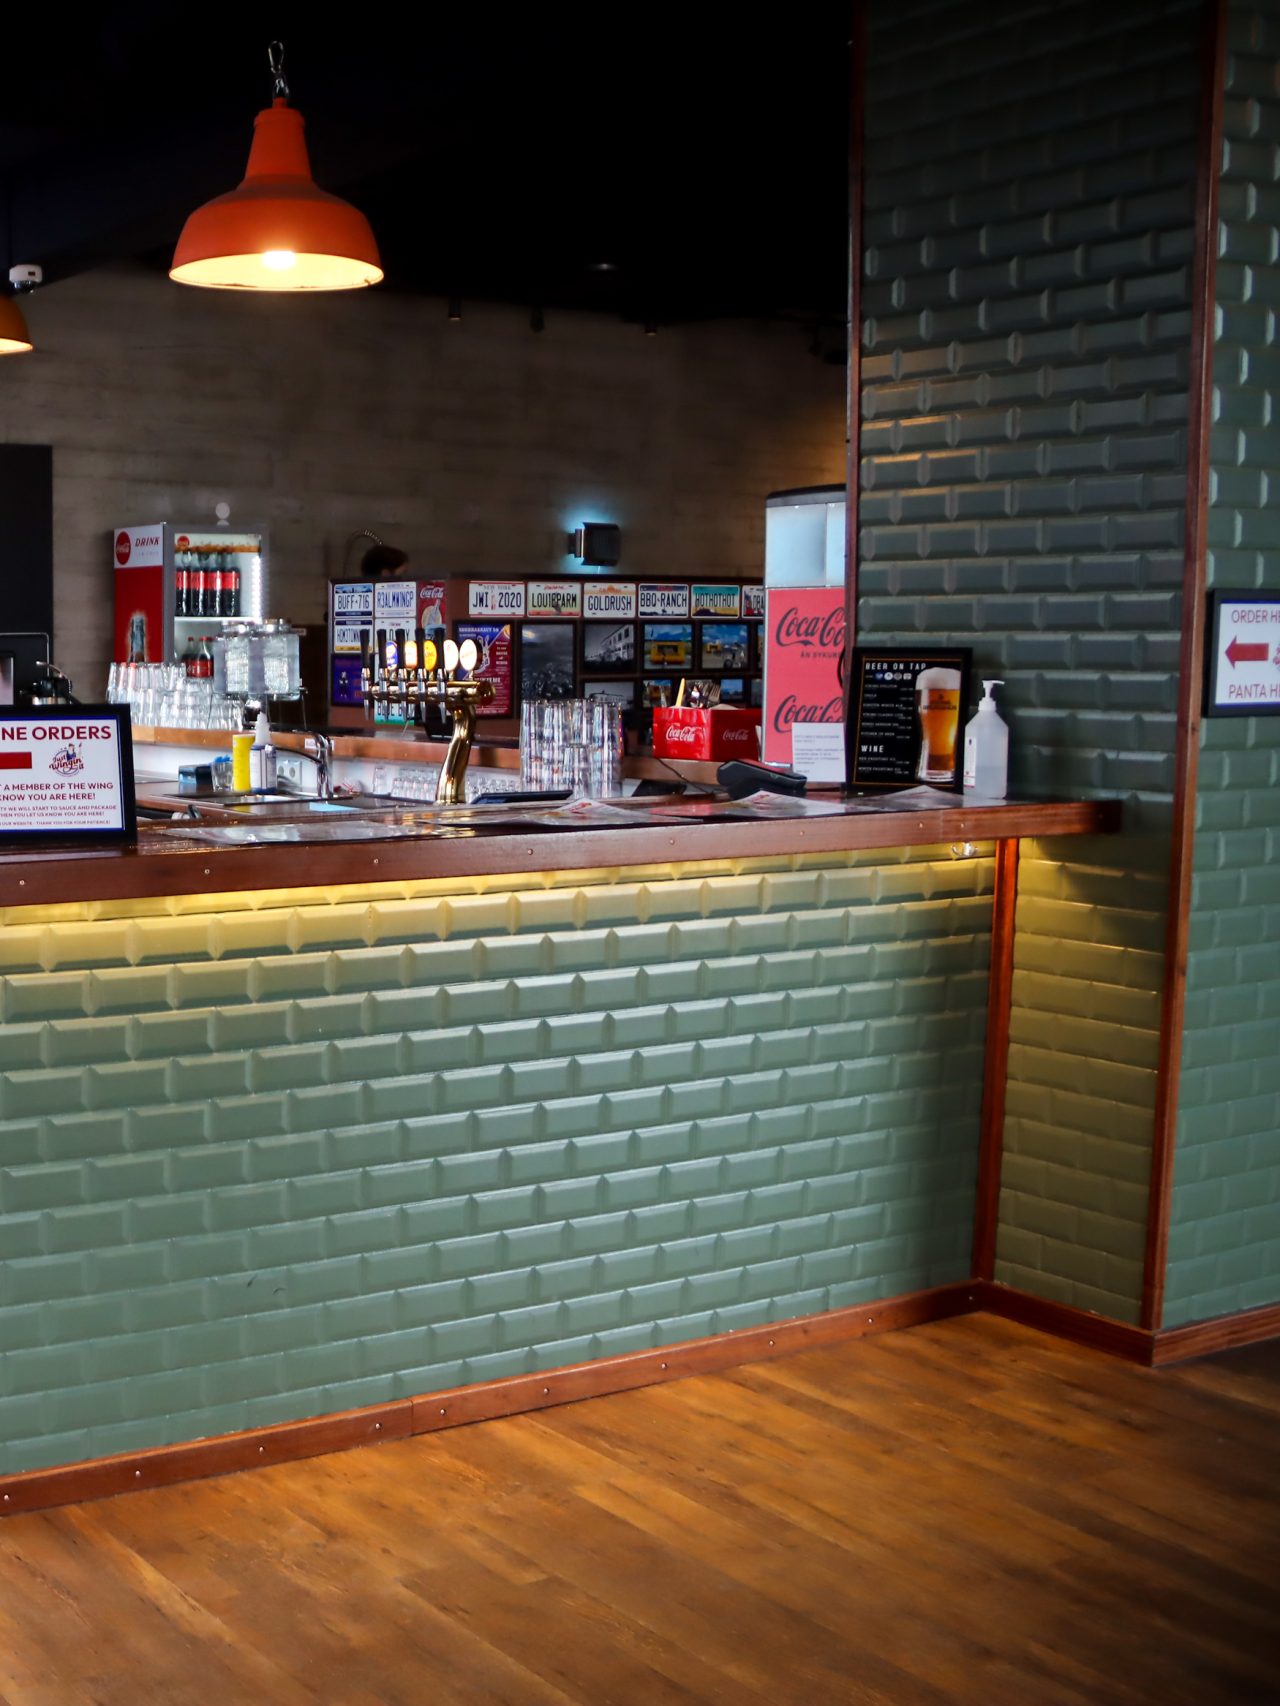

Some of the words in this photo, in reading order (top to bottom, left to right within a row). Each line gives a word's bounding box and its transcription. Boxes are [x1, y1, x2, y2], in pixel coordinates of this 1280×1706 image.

[134, 537, 160, 547] DRINK
[472, 592, 489, 608] JWI
[498, 592, 522, 608] 2020
[587, 595, 632, 611] GOLDRUSH
[695, 593, 736, 608] HOTHOTHOT
[1231, 609, 1268, 623] ORDER
[776, 607, 846, 647] Coca-Co
[865, 662, 888, 670] BEER
[909, 663, 927, 671] TAP
[1228, 683, 1267, 699] PANTA
[32, 725, 112, 740] ORDERS
[666, 725, 697, 742] Coca-Cola
[861, 745, 884, 753] WINE
[3, 783, 10, 791] A
[12, 783, 51, 791] MEMBER
[67, 782, 86, 790] THE
[27, 793, 47, 801] YOU
[68, 792, 96, 800] HERE!
